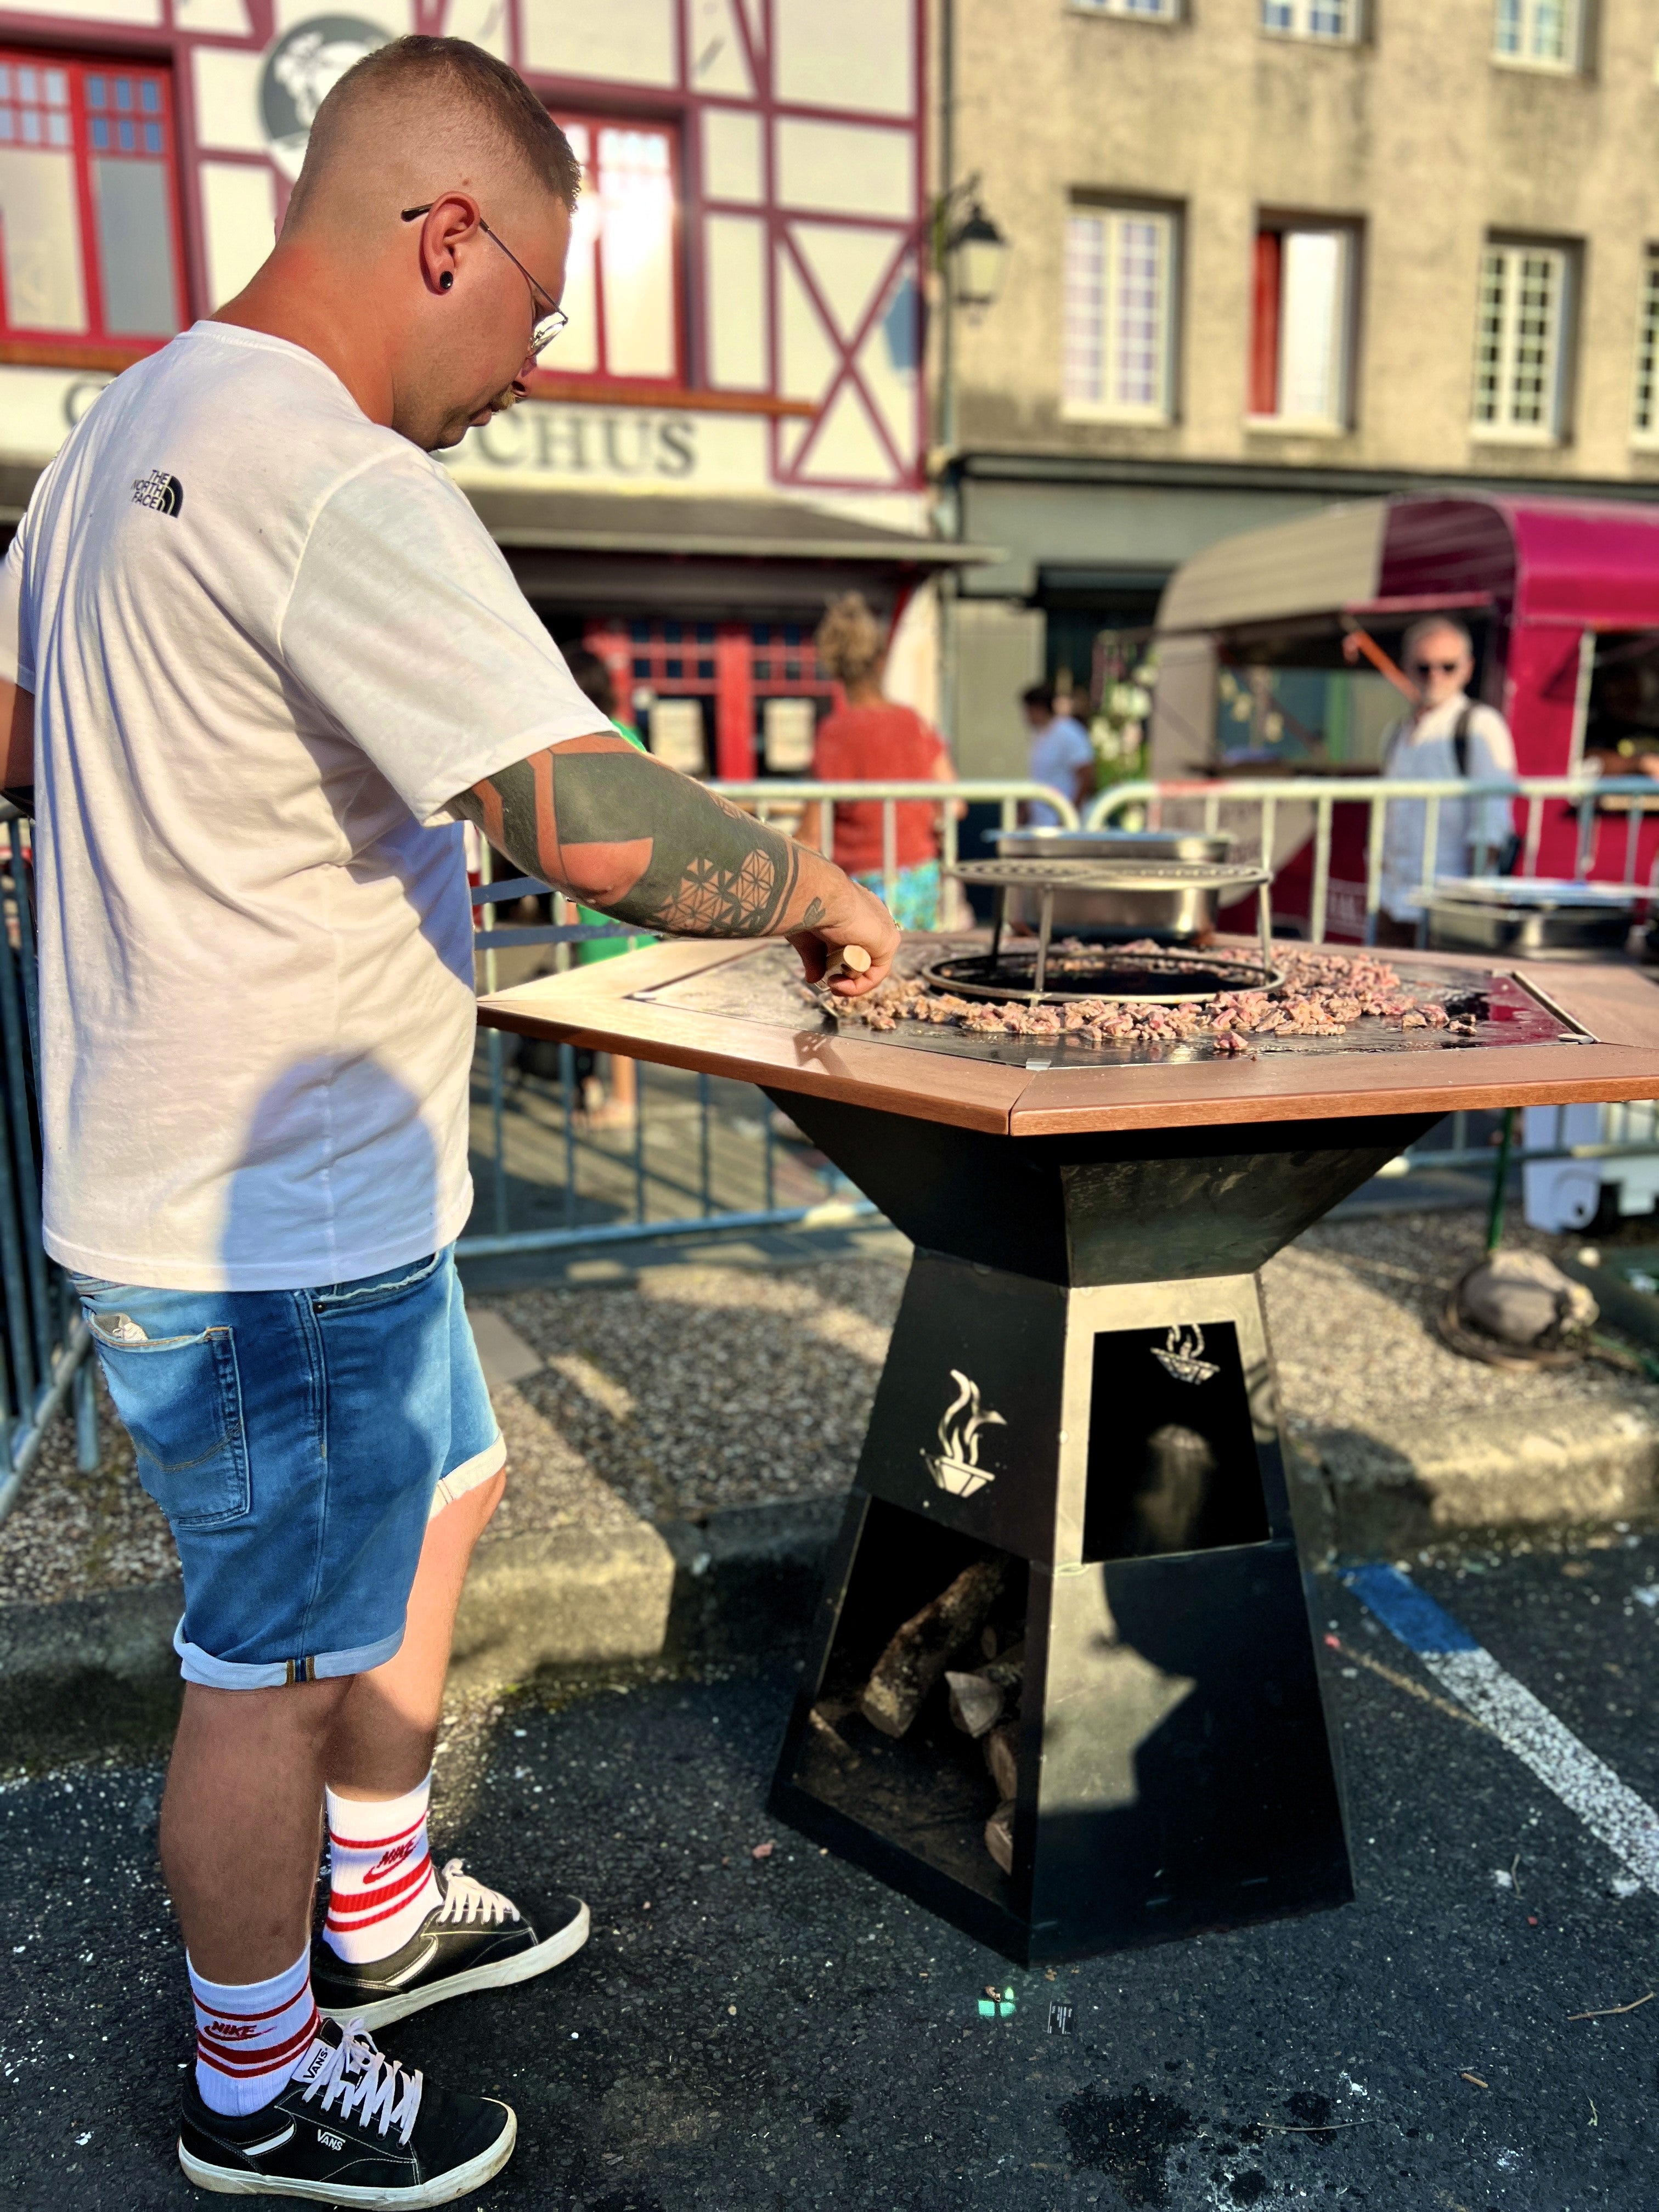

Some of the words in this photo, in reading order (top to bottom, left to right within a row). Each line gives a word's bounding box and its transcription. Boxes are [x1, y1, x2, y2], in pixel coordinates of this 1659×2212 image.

[440, 406, 696, 477] CHUS
[149, 469, 170, 485] THE
[131, 479, 166, 497] NORTH
[132, 492, 160, 509] FACE
[376, 1835, 417, 1868] NIKE
[212, 2021, 257, 2037] NIKE
[303, 2047, 328, 2079] VANS
[317, 2129, 346, 2152] VANS
